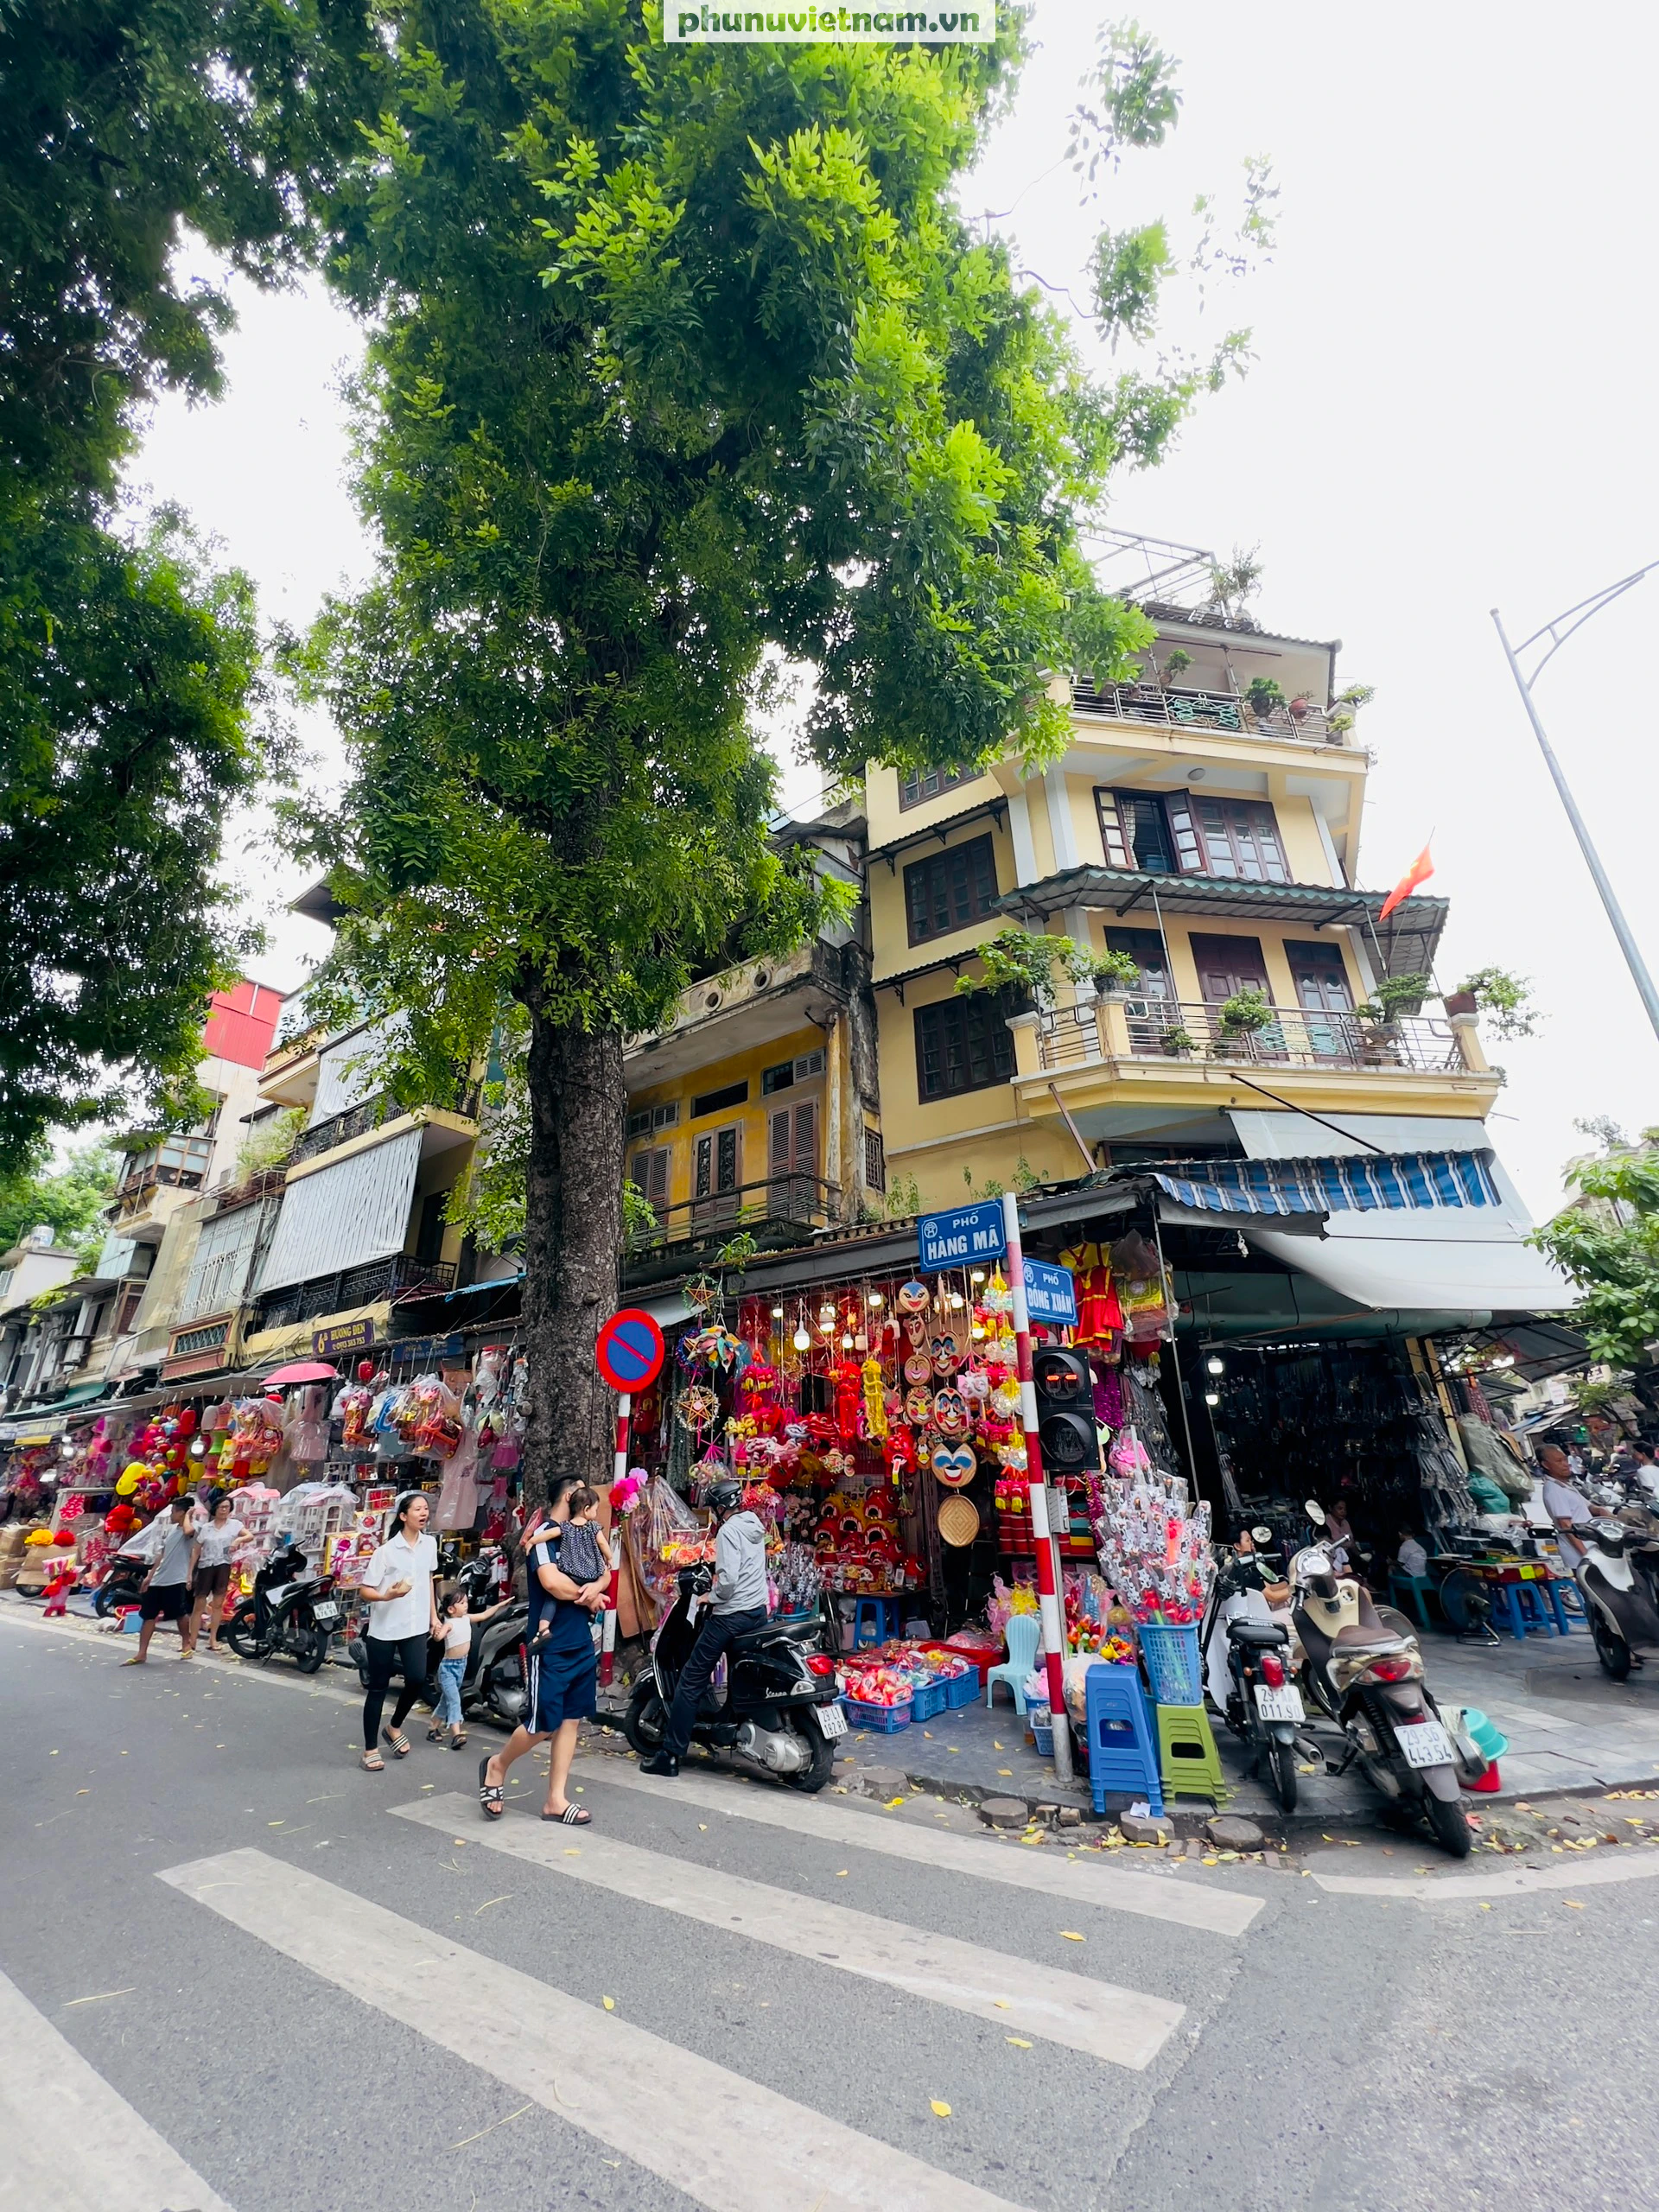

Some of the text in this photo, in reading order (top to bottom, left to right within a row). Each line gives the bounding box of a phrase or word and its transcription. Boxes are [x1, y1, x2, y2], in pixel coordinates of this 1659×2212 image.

[952, 1211, 979, 1229] PHỐ
[927, 1224, 1000, 1260] HÀNG MÃ
[1042, 1272, 1059, 1286] PHỐ
[1051, 1290, 1073, 1314] XUÂN
[1408, 1744, 1452, 1764] 443.54
